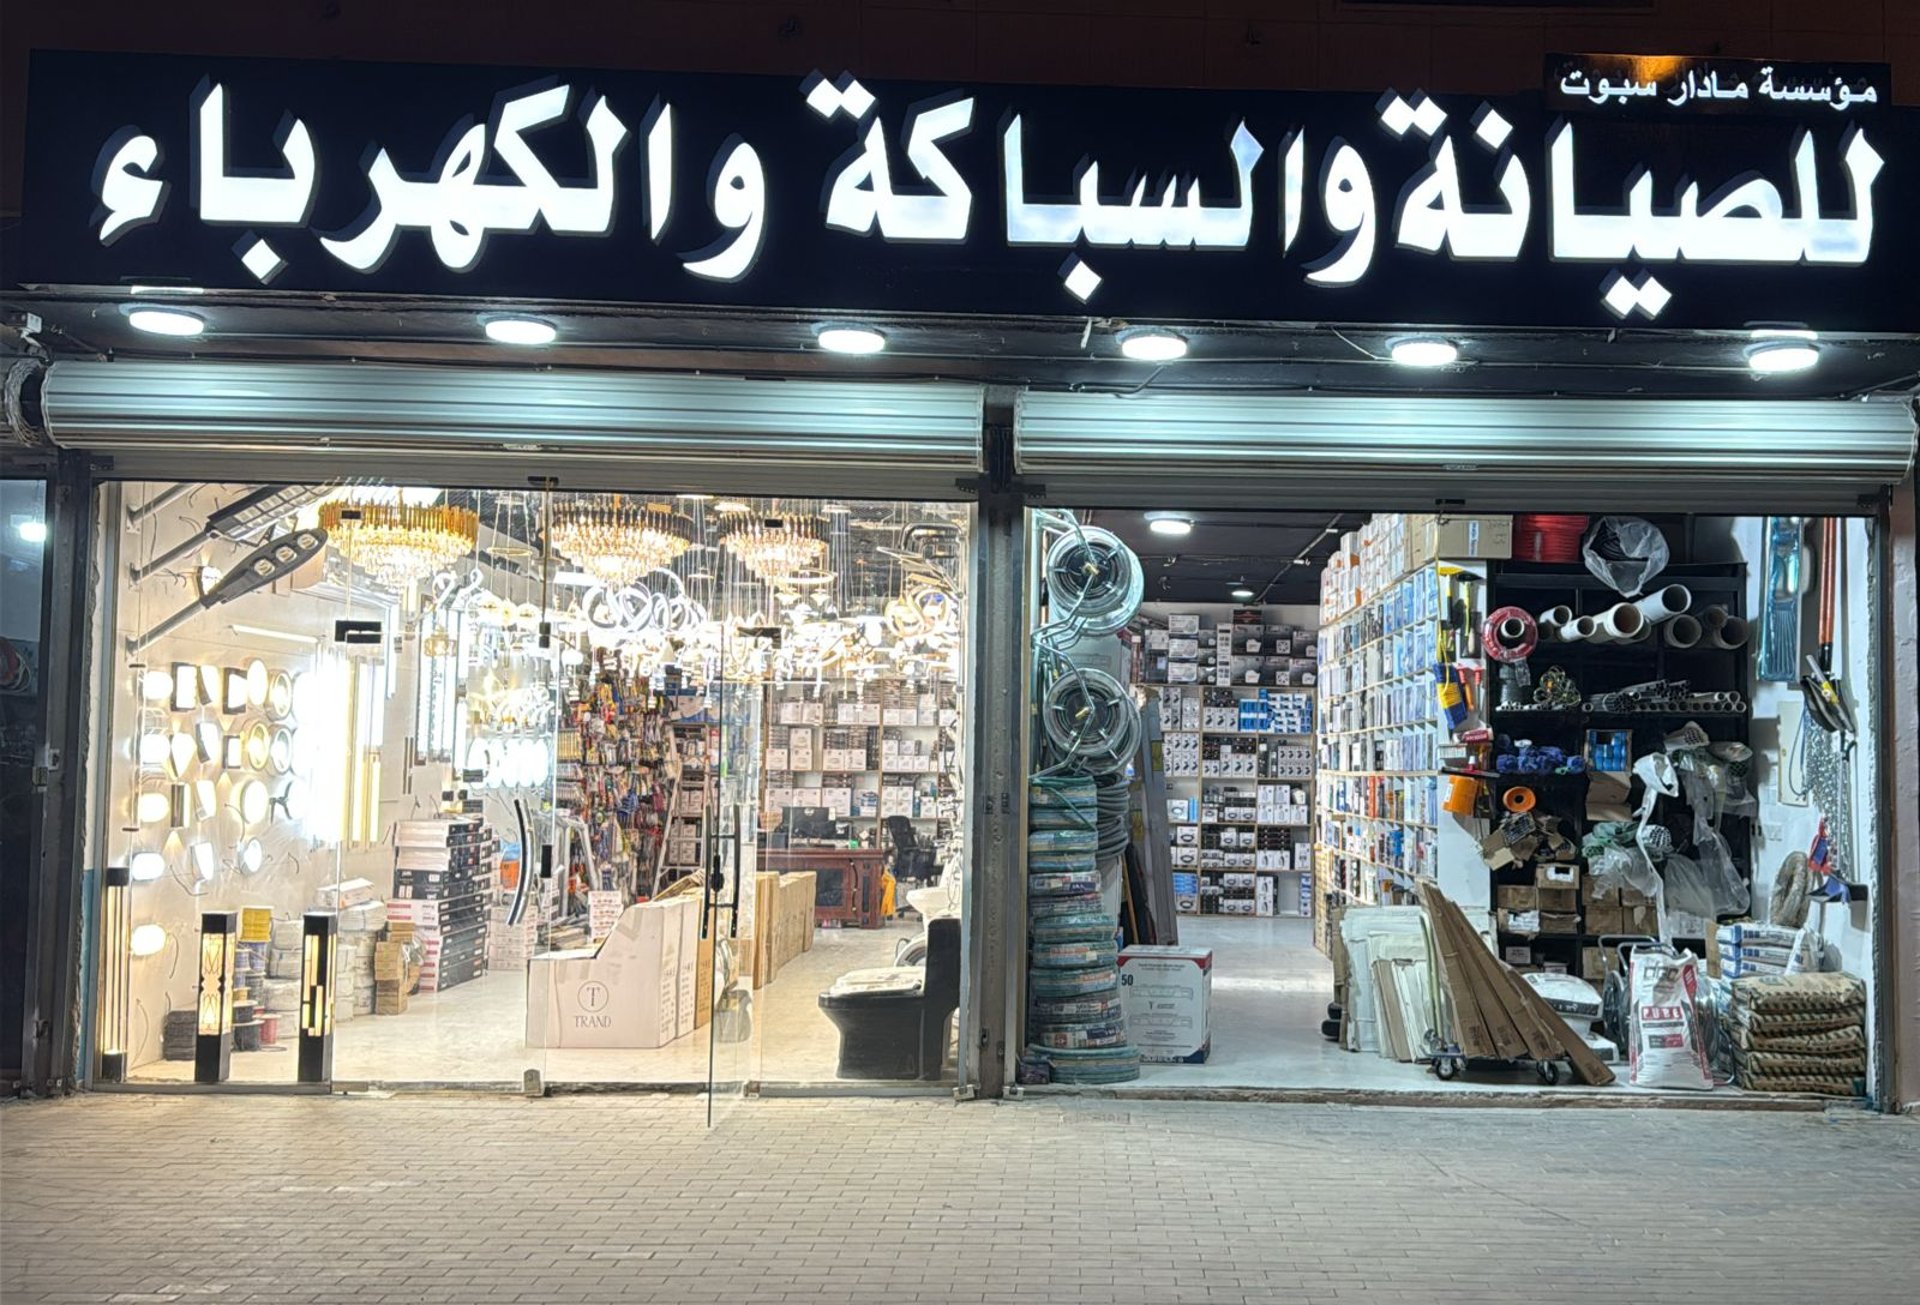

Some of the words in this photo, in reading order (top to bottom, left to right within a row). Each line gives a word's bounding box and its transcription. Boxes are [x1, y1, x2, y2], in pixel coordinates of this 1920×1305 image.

[1560, 69, 1657, 104] سبوت
[1667, 70, 1749, 106] مادار
[1758, 67, 1877, 110] مؤسسة
[99, 82, 766, 282] والكهرباء
[806, 78, 1376, 303] والسباكة
[1379, 95, 1885, 320] للصيانة
[1121, 973, 1134, 986] 50
